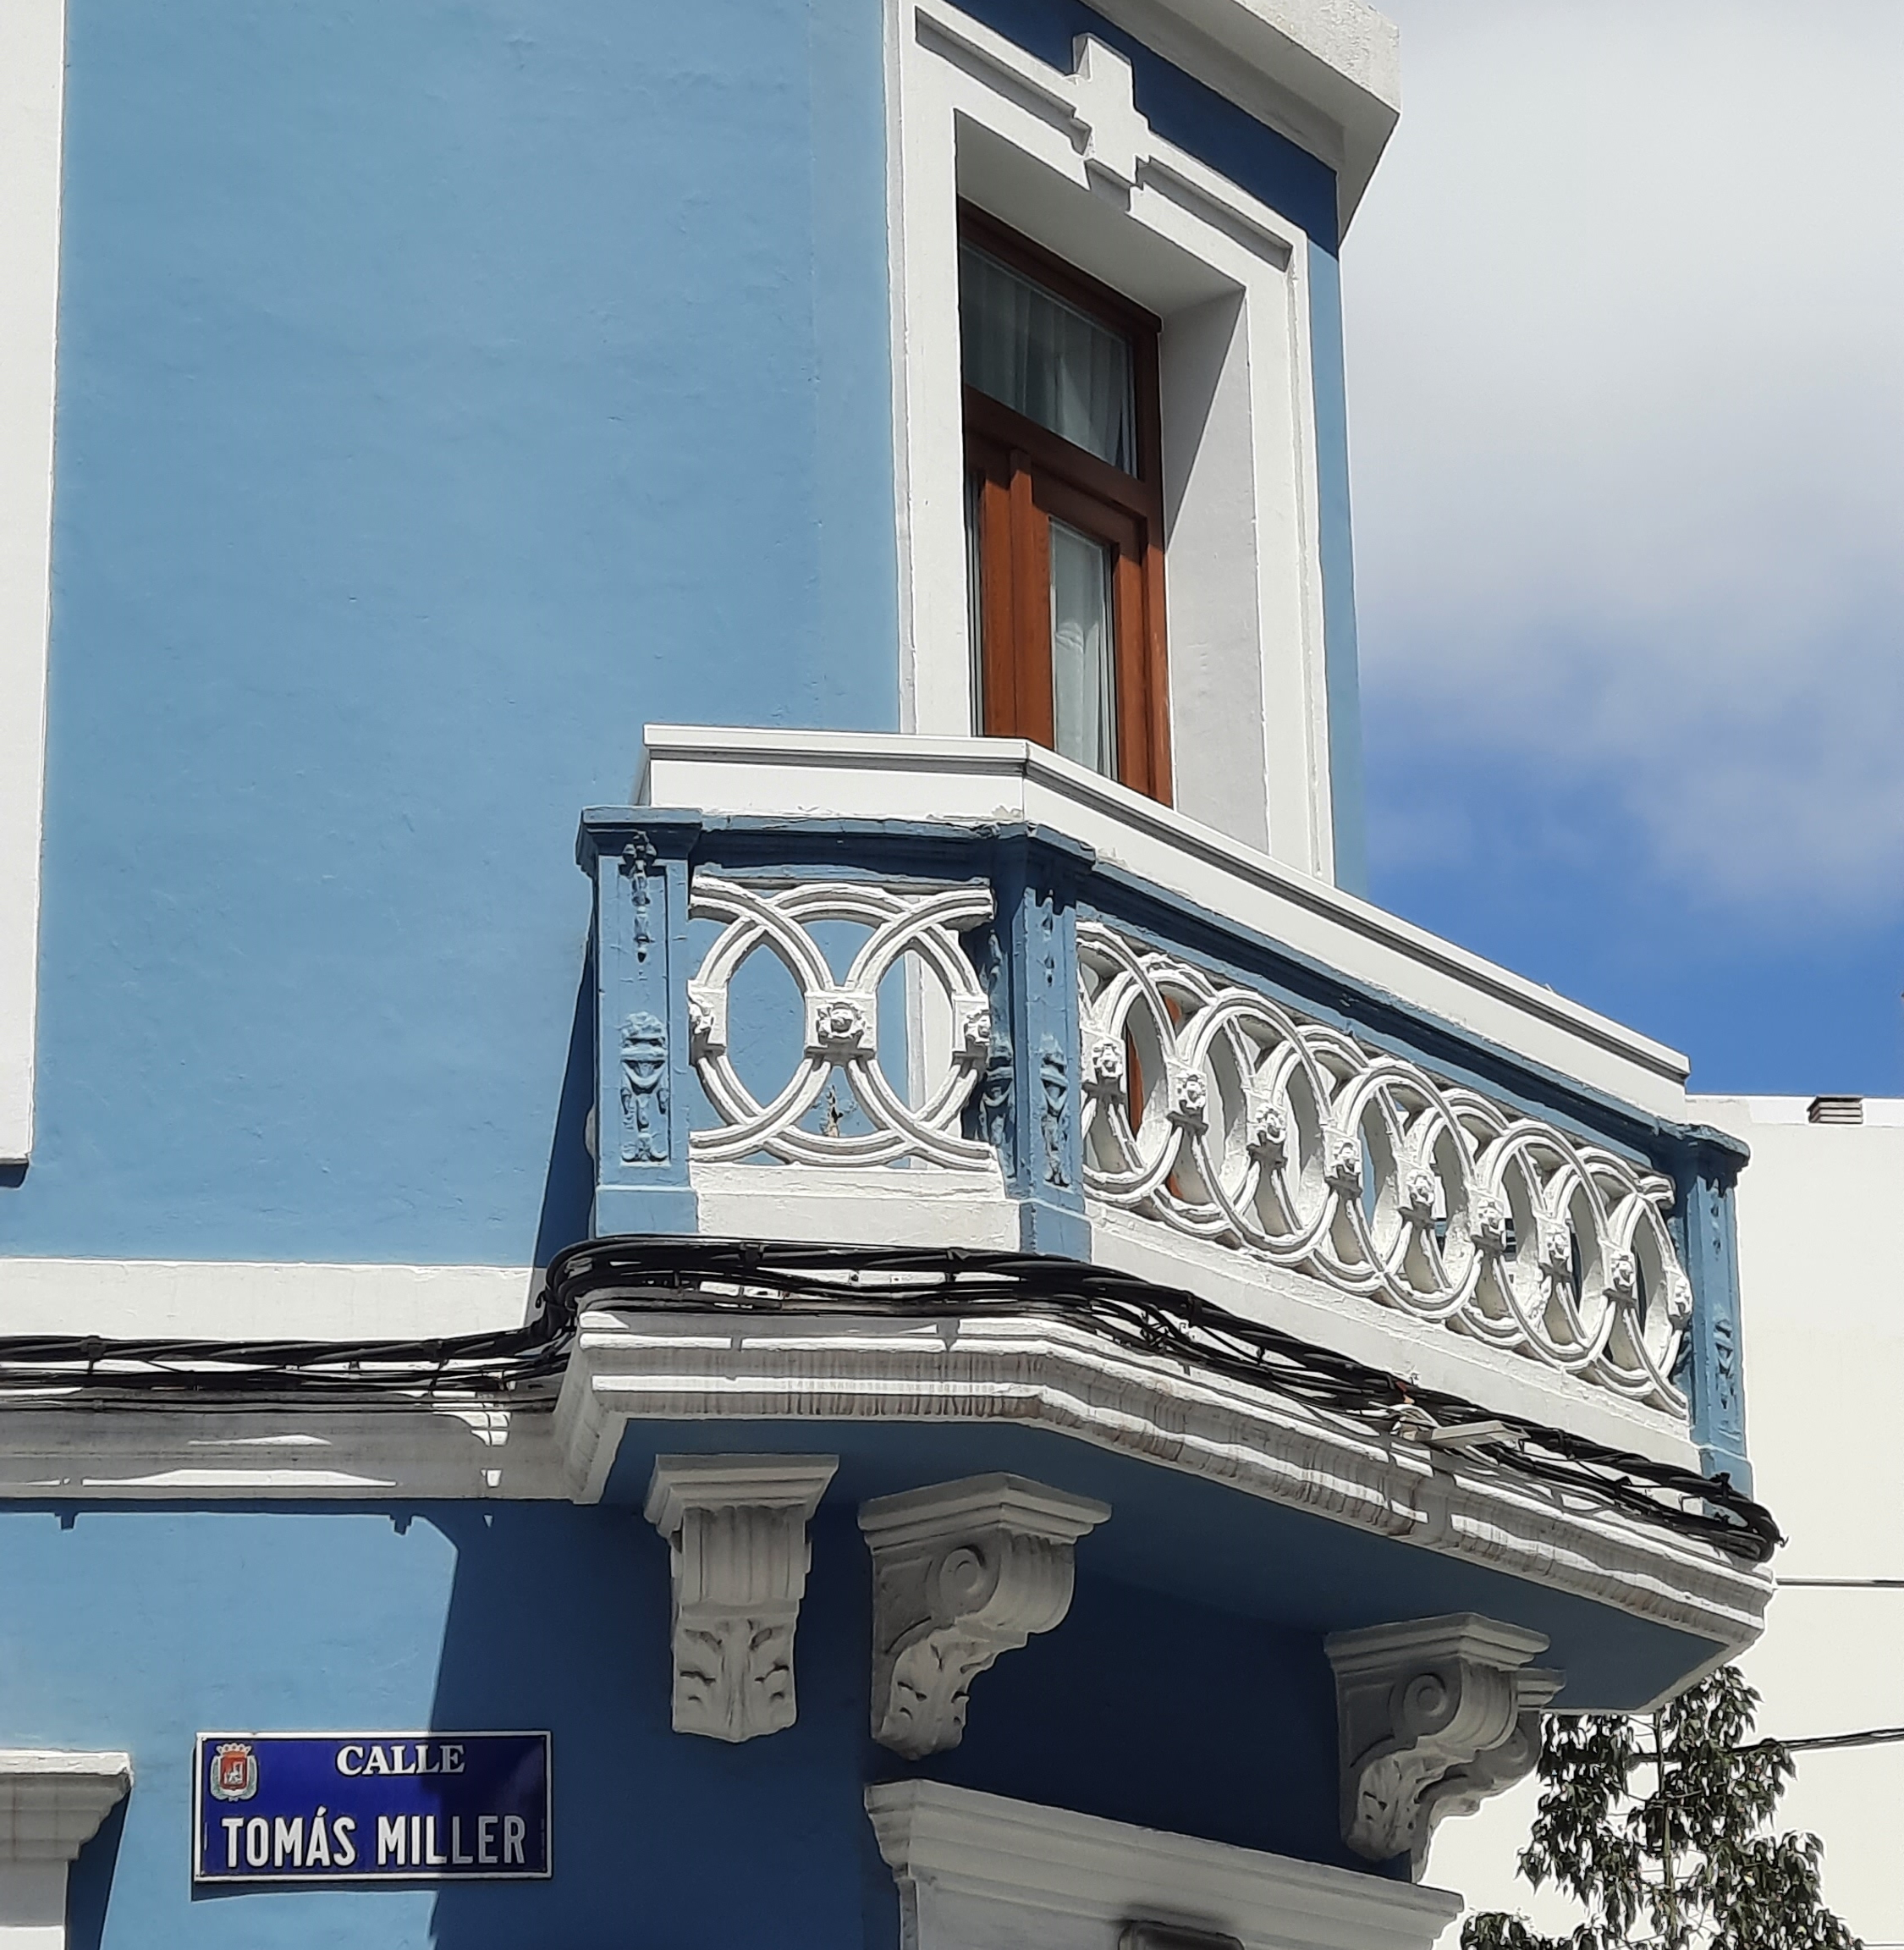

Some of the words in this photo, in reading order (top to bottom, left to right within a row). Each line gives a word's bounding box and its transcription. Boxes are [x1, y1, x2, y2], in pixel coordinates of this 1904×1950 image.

[337, 1744, 465, 1776] CALLE
[222, 1805, 357, 1868] TOMÁS
[377, 1814, 526, 1866] MILLER
